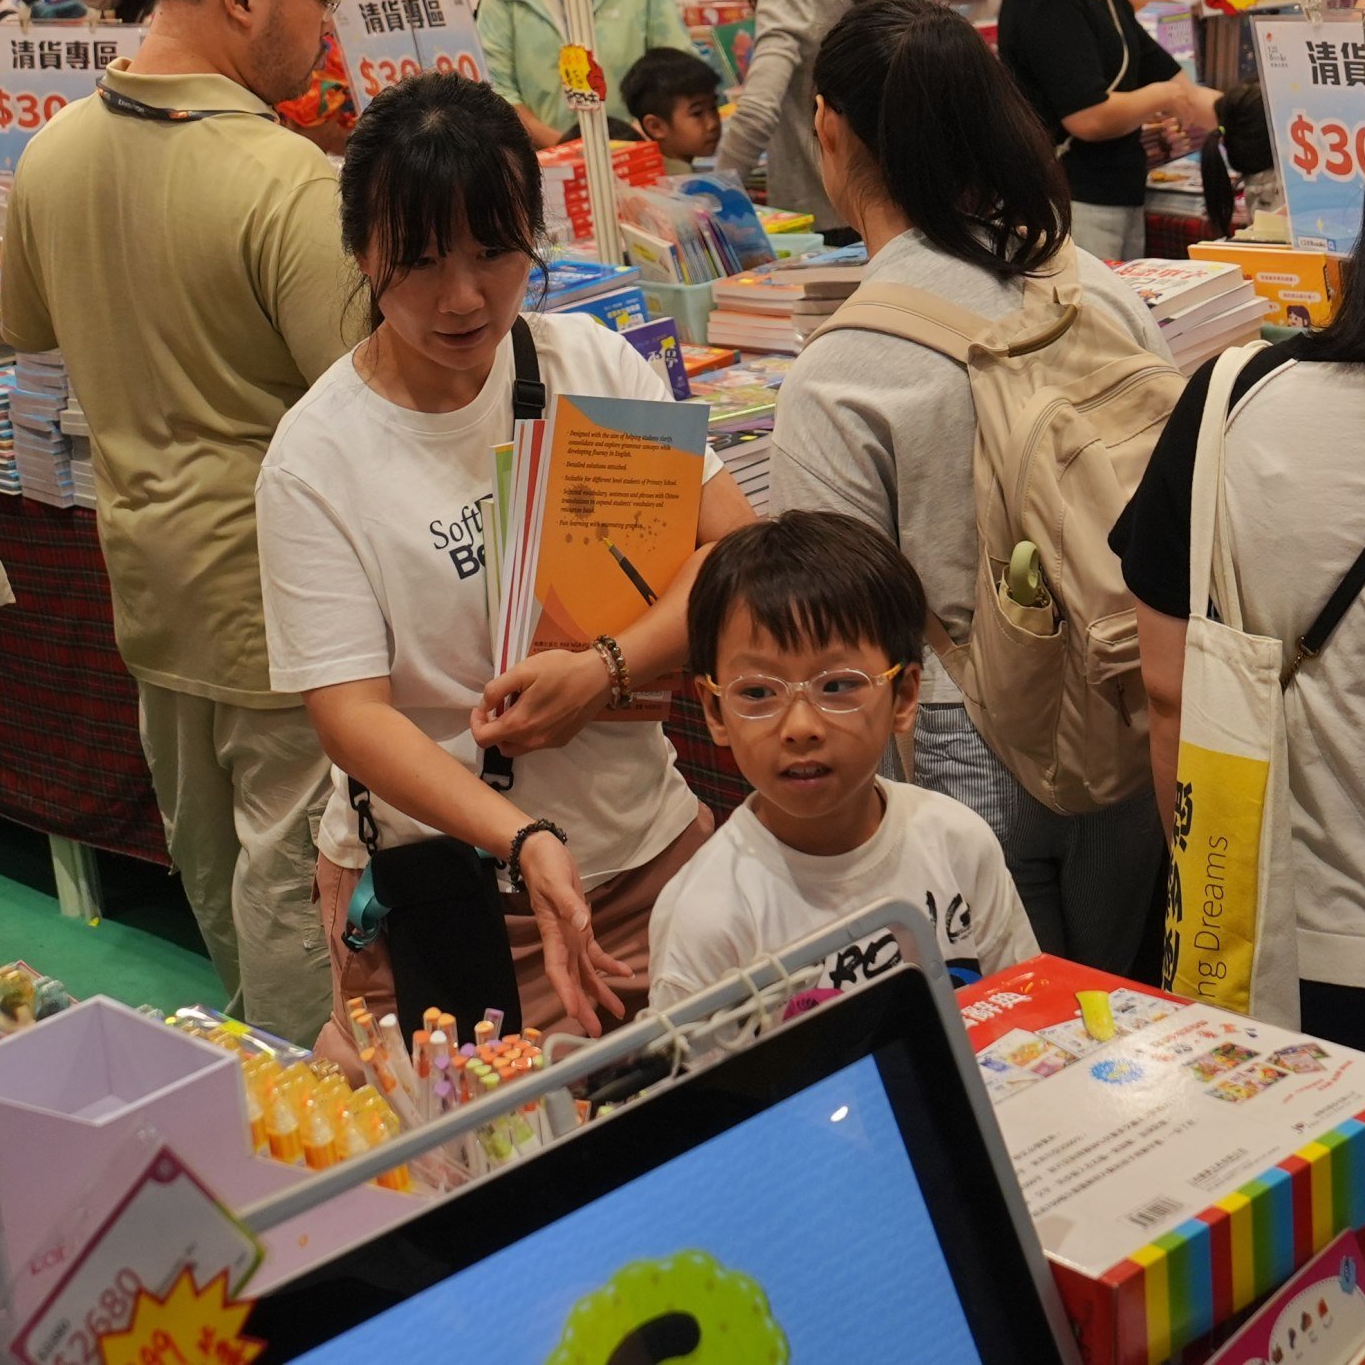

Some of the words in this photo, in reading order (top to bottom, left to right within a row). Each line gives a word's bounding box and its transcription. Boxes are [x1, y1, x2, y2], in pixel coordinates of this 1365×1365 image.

[11, 39, 119, 71] 清貨專區
[1193, 834, 1230, 952] Dreams
